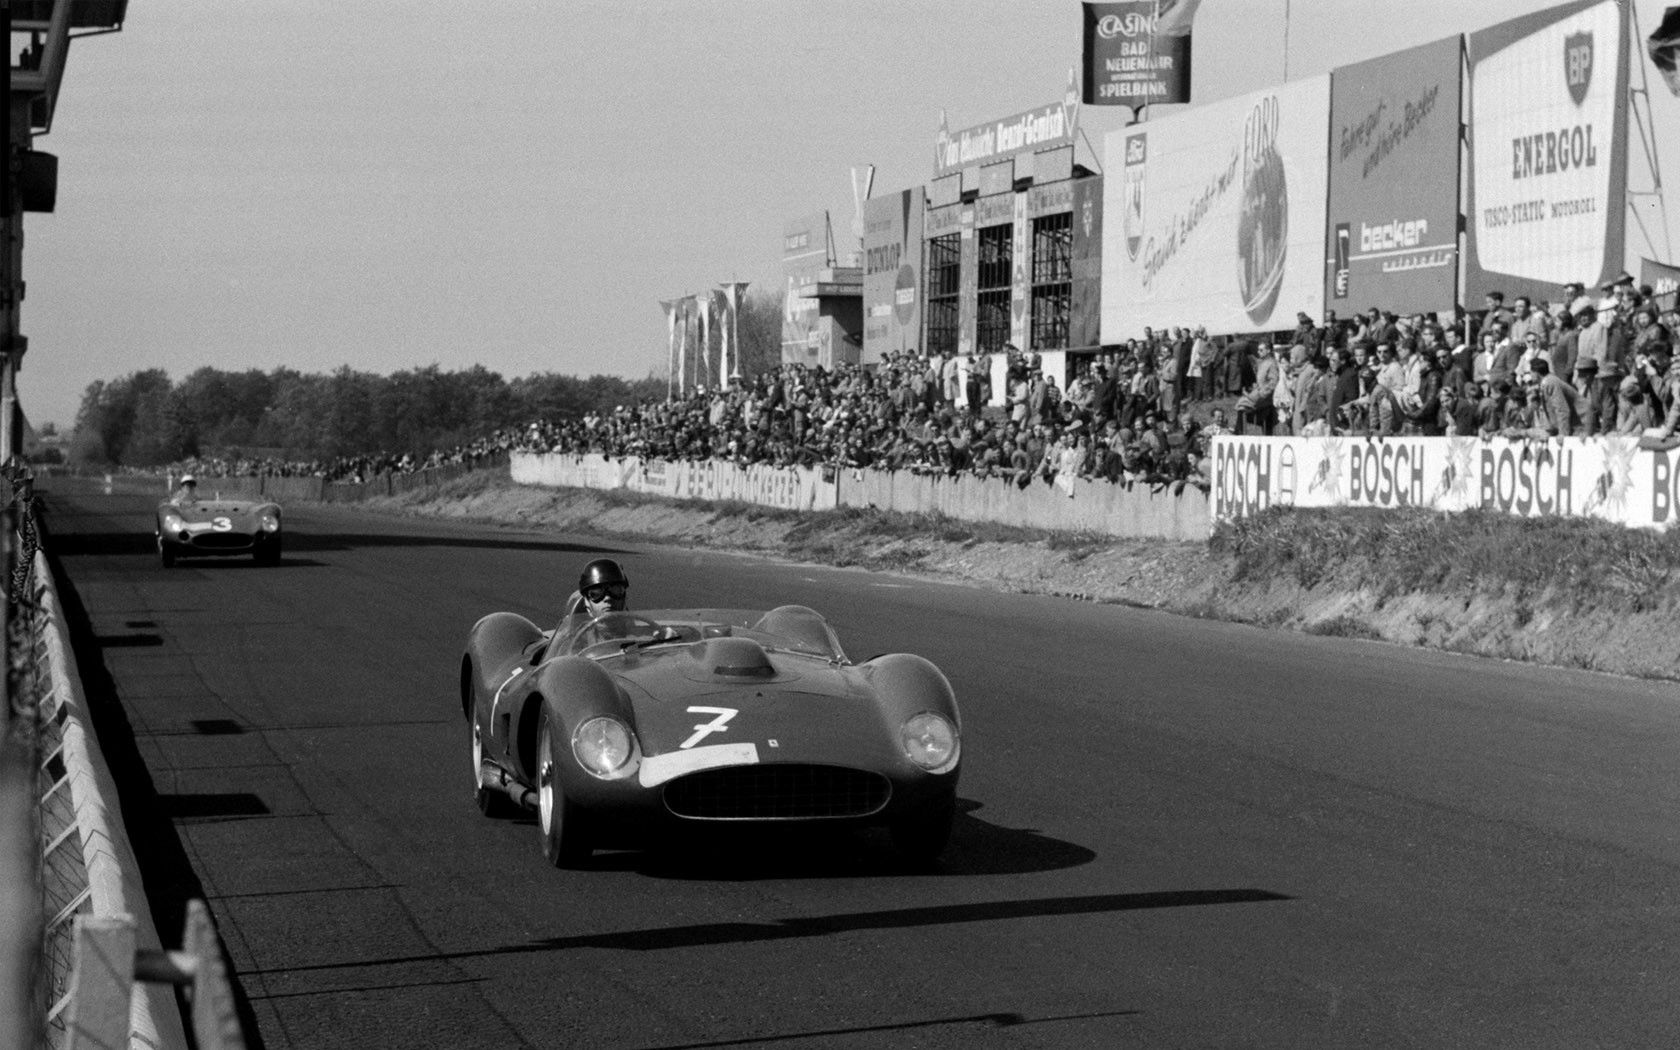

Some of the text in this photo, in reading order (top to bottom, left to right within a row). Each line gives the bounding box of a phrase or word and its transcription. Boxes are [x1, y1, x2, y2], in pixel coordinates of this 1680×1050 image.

[1120, 41, 1147, 56] BAD
[1568, 45, 1590, 86] BP
[1099, 81, 1168, 97] SPIELBANK
[1403, 84, 1439, 138] Becker
[1243, 95, 1279, 192] FORD
[1512, 124, 1597, 180] ENERGOL
[1483, 199, 1545, 229] VISCO-STATIC
[1360, 218, 1428, 252] becker
[867, 242, 901, 275] DUNLOP
[1216, 442, 1271, 516] BOSCH
[1351, 443, 1424, 506] BOSCH
[1481, 447, 1572, 517] BOSCH
[212, 516, 232, 532] 3
[679, 705, 739, 749] 7
